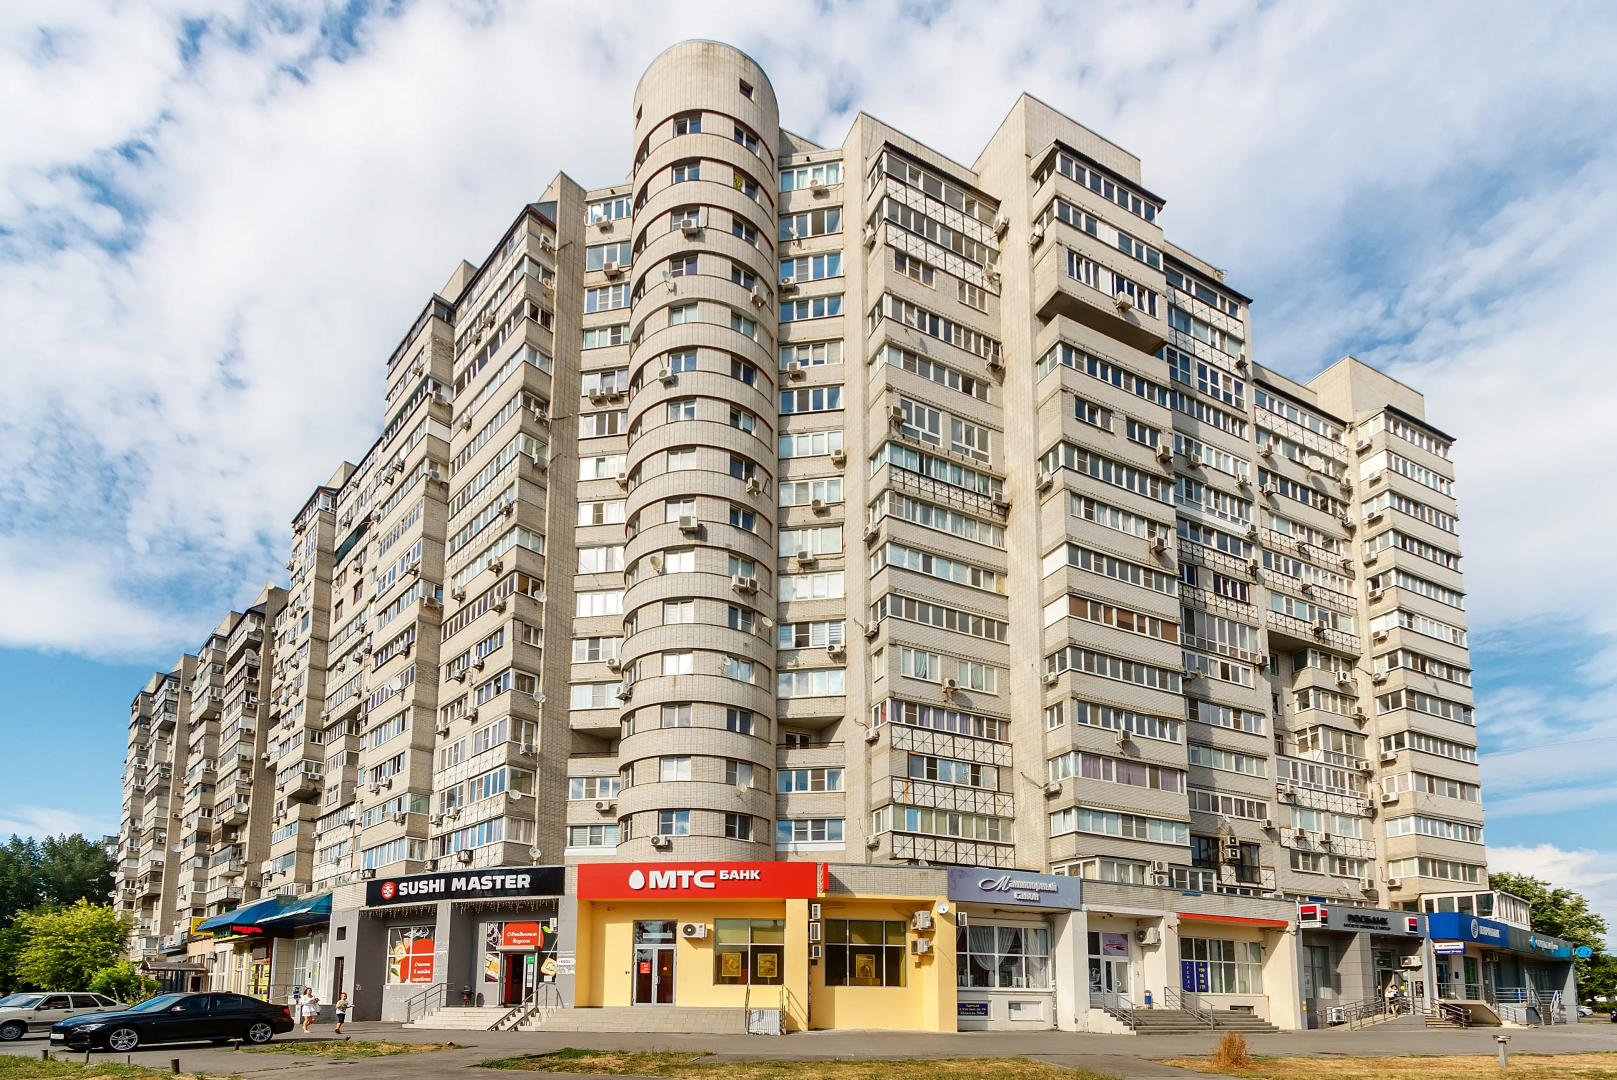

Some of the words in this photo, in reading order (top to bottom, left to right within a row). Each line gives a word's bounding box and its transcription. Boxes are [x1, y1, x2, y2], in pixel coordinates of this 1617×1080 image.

[398, 878, 445, 896] SUSHI
[451, 874, 531, 891] MASTER
[649, 869, 716, 889] МТС
[719, 869, 761, 880] БАНК
[978, 875, 1057, 892] Маникюрный
[1013, 891, 1040, 901] салон
[1347, 914, 1388, 925] РОСБАНК
